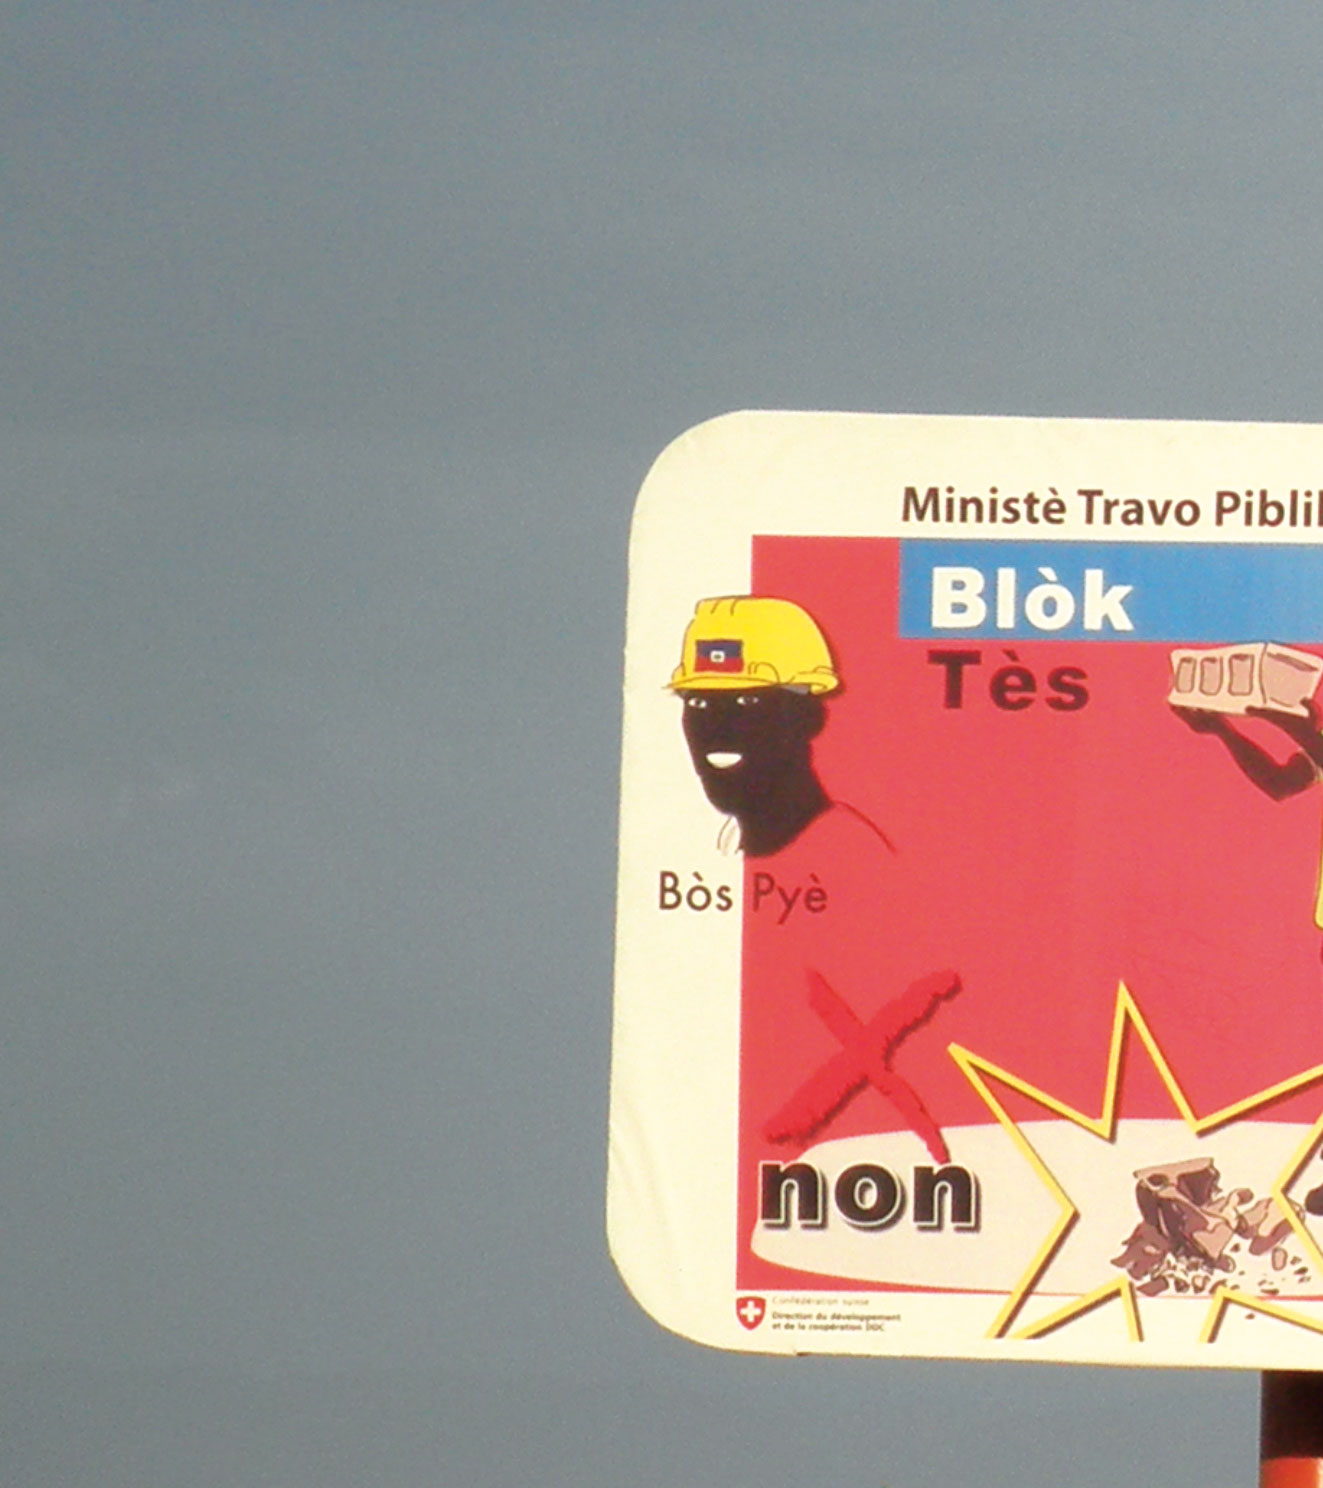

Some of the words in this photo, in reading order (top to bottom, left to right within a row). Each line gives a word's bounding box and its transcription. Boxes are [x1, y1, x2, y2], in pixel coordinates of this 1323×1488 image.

[901, 486, 1067, 526] Ministè
[1077, 489, 1201, 527] Travo
[931, 566, 1135, 632] Blòk
[927, 649, 1090, 711] Tès
[659, 870, 733, 912] Bòs
[753, 872, 828, 925] Pyè
[759, 1160, 983, 1233] non
